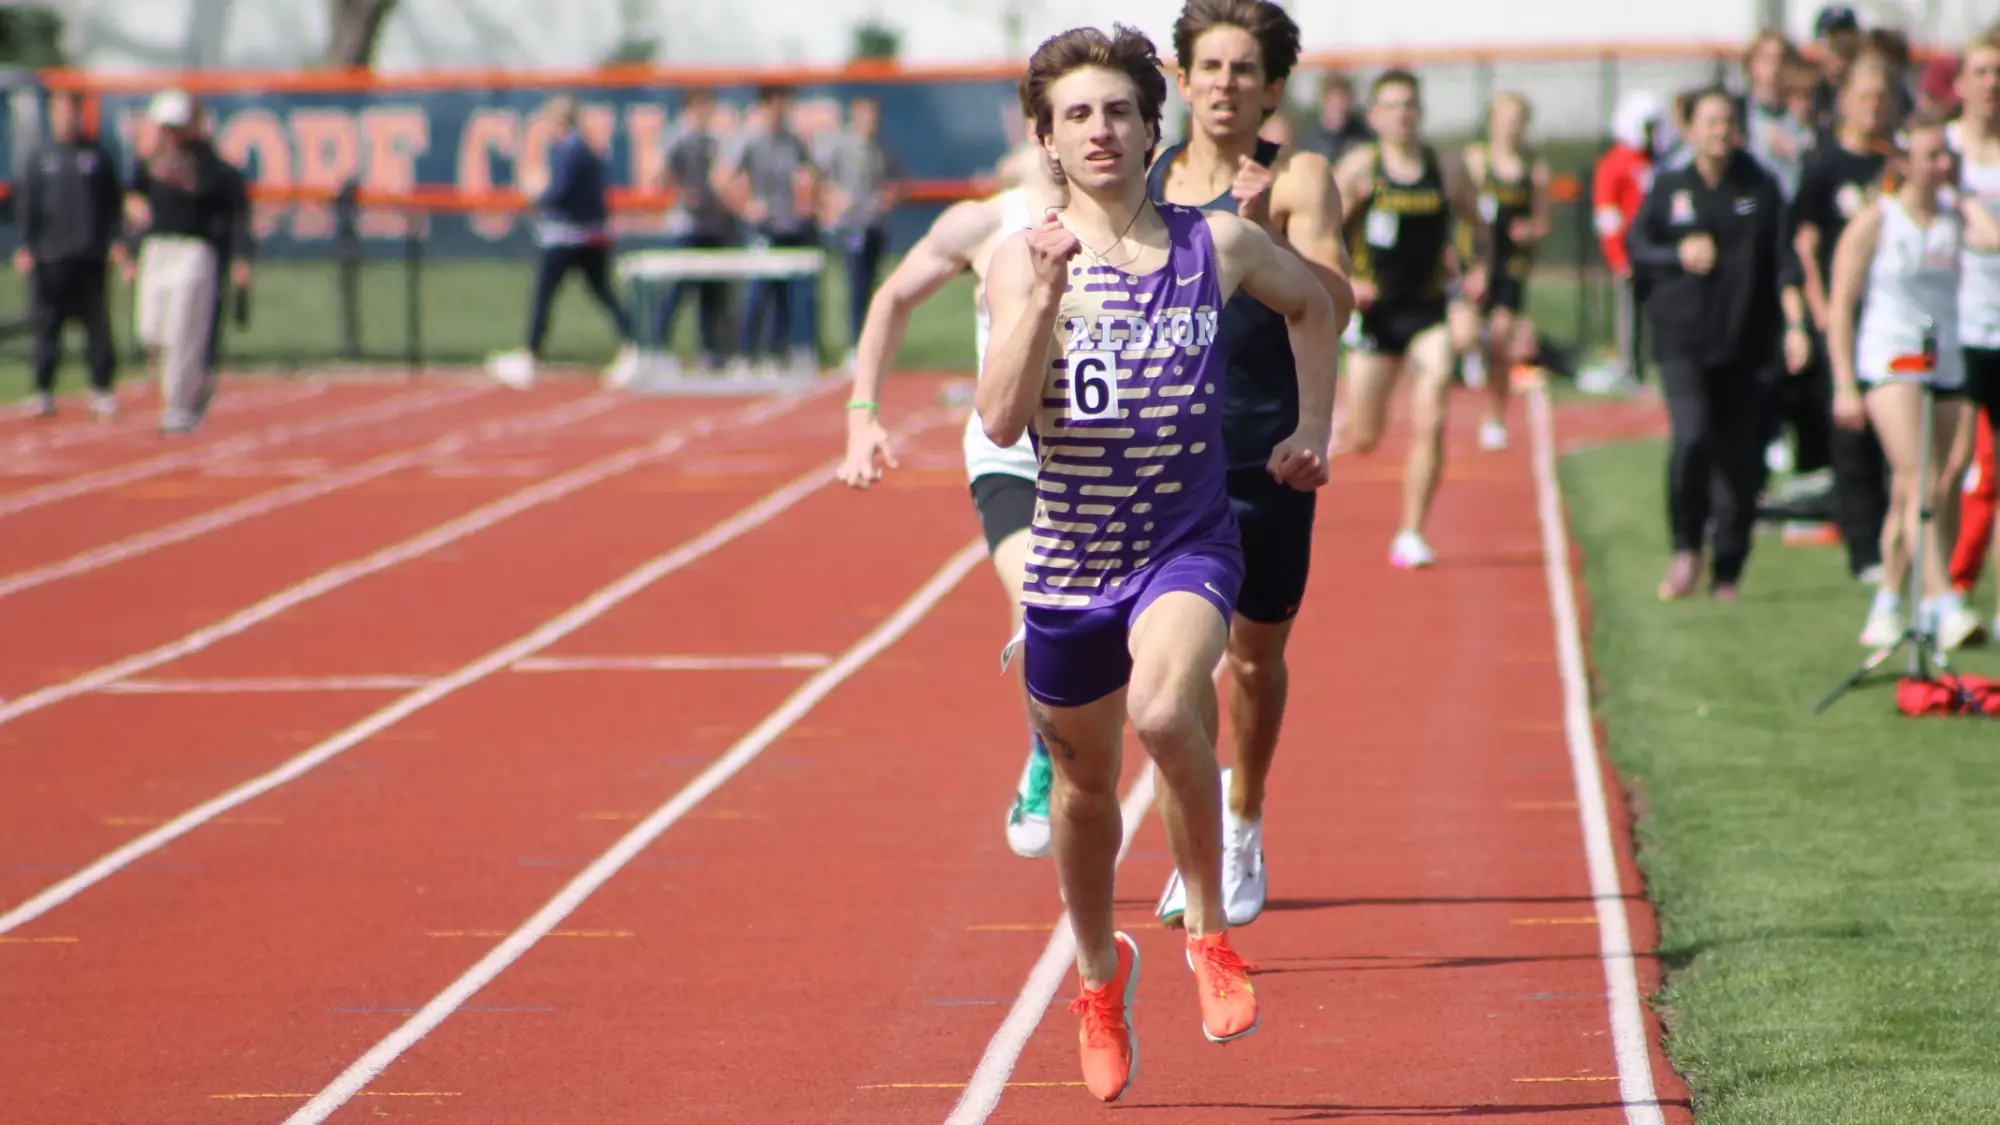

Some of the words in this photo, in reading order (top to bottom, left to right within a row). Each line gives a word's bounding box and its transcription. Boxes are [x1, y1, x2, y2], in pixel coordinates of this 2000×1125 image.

[116, 105, 432, 240] OPE
[1067, 310, 1218, 351] ALBION
[1074, 357, 1110, 415] 6
